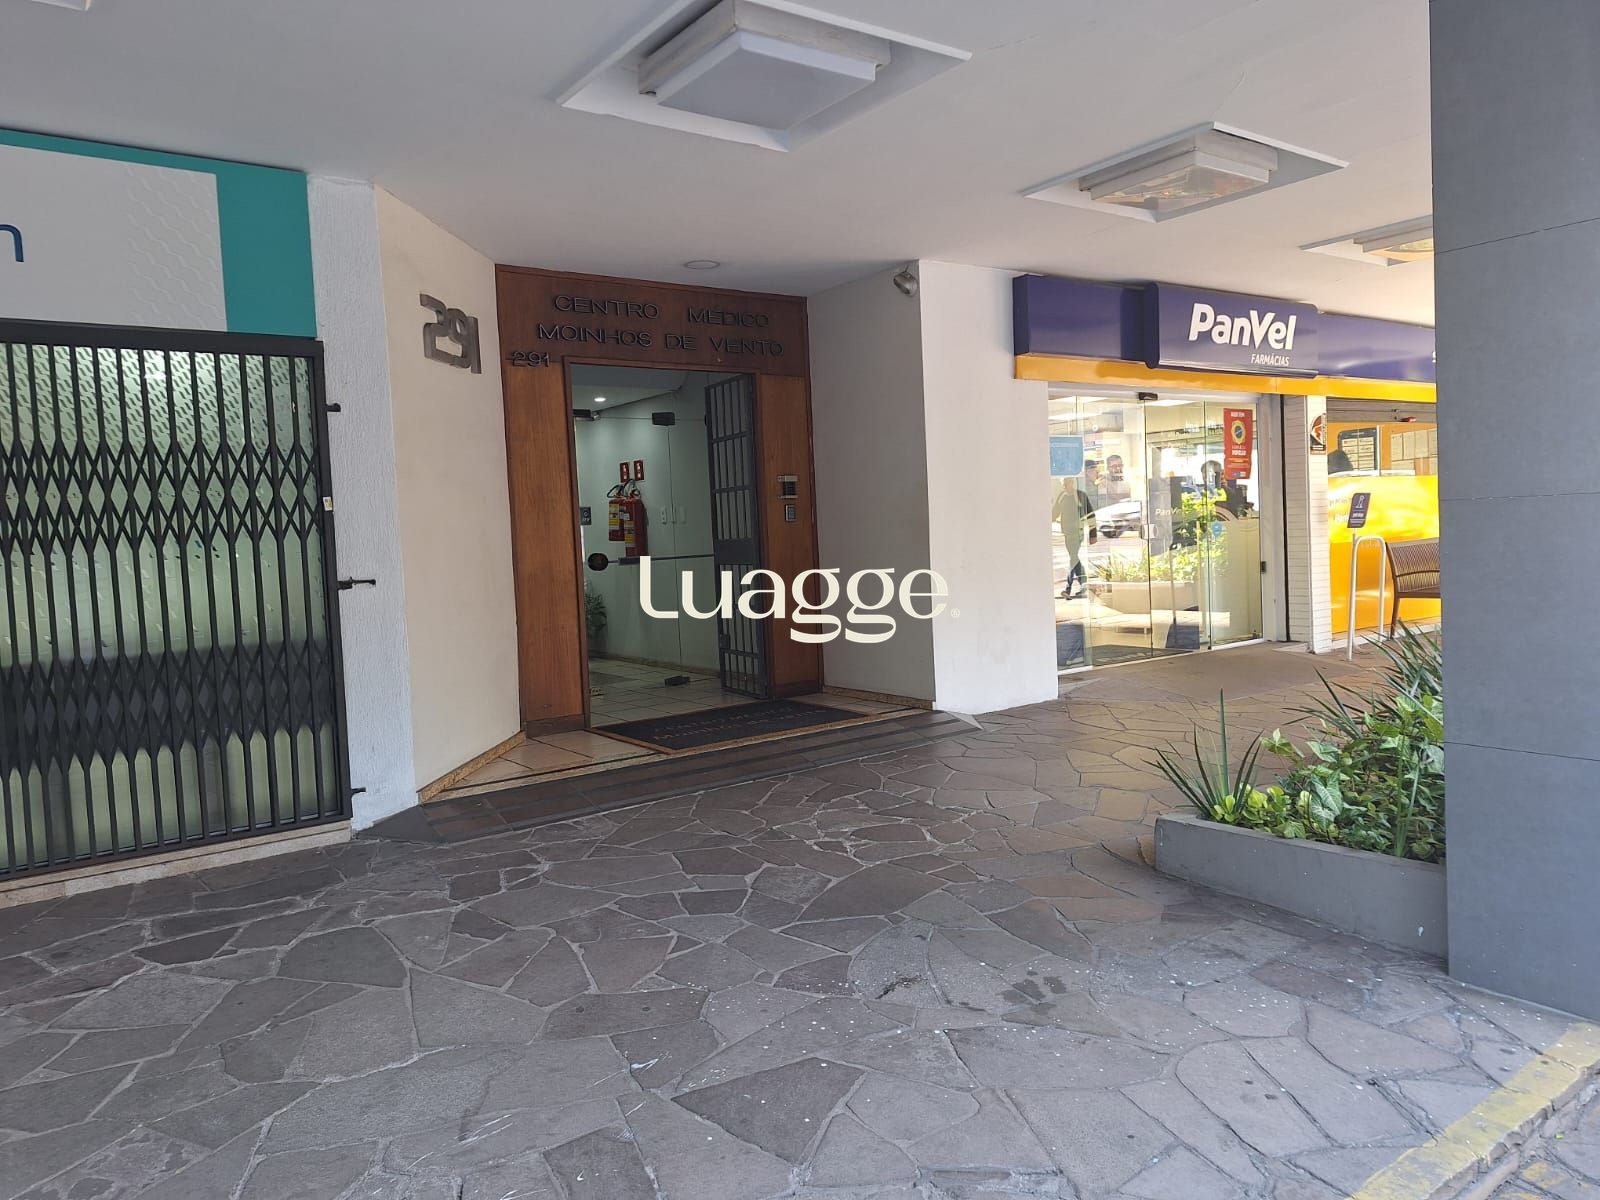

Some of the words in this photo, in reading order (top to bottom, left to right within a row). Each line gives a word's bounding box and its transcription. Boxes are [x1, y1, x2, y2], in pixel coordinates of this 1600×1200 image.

[554, 295, 660, 319] CENTRO
[688, 303, 769, 327] MÉDICO
[1189, 303, 1297, 350] PanVel
[420, 293, 481, 374] 291
[537, 323, 653, 347] MOINHOS
[664, 333, 697, 351] DE
[709, 336, 784, 357] VENTO
[512, 351, 550, 367] 291
[1250, 353, 1290, 367] FARMÁCIAS
